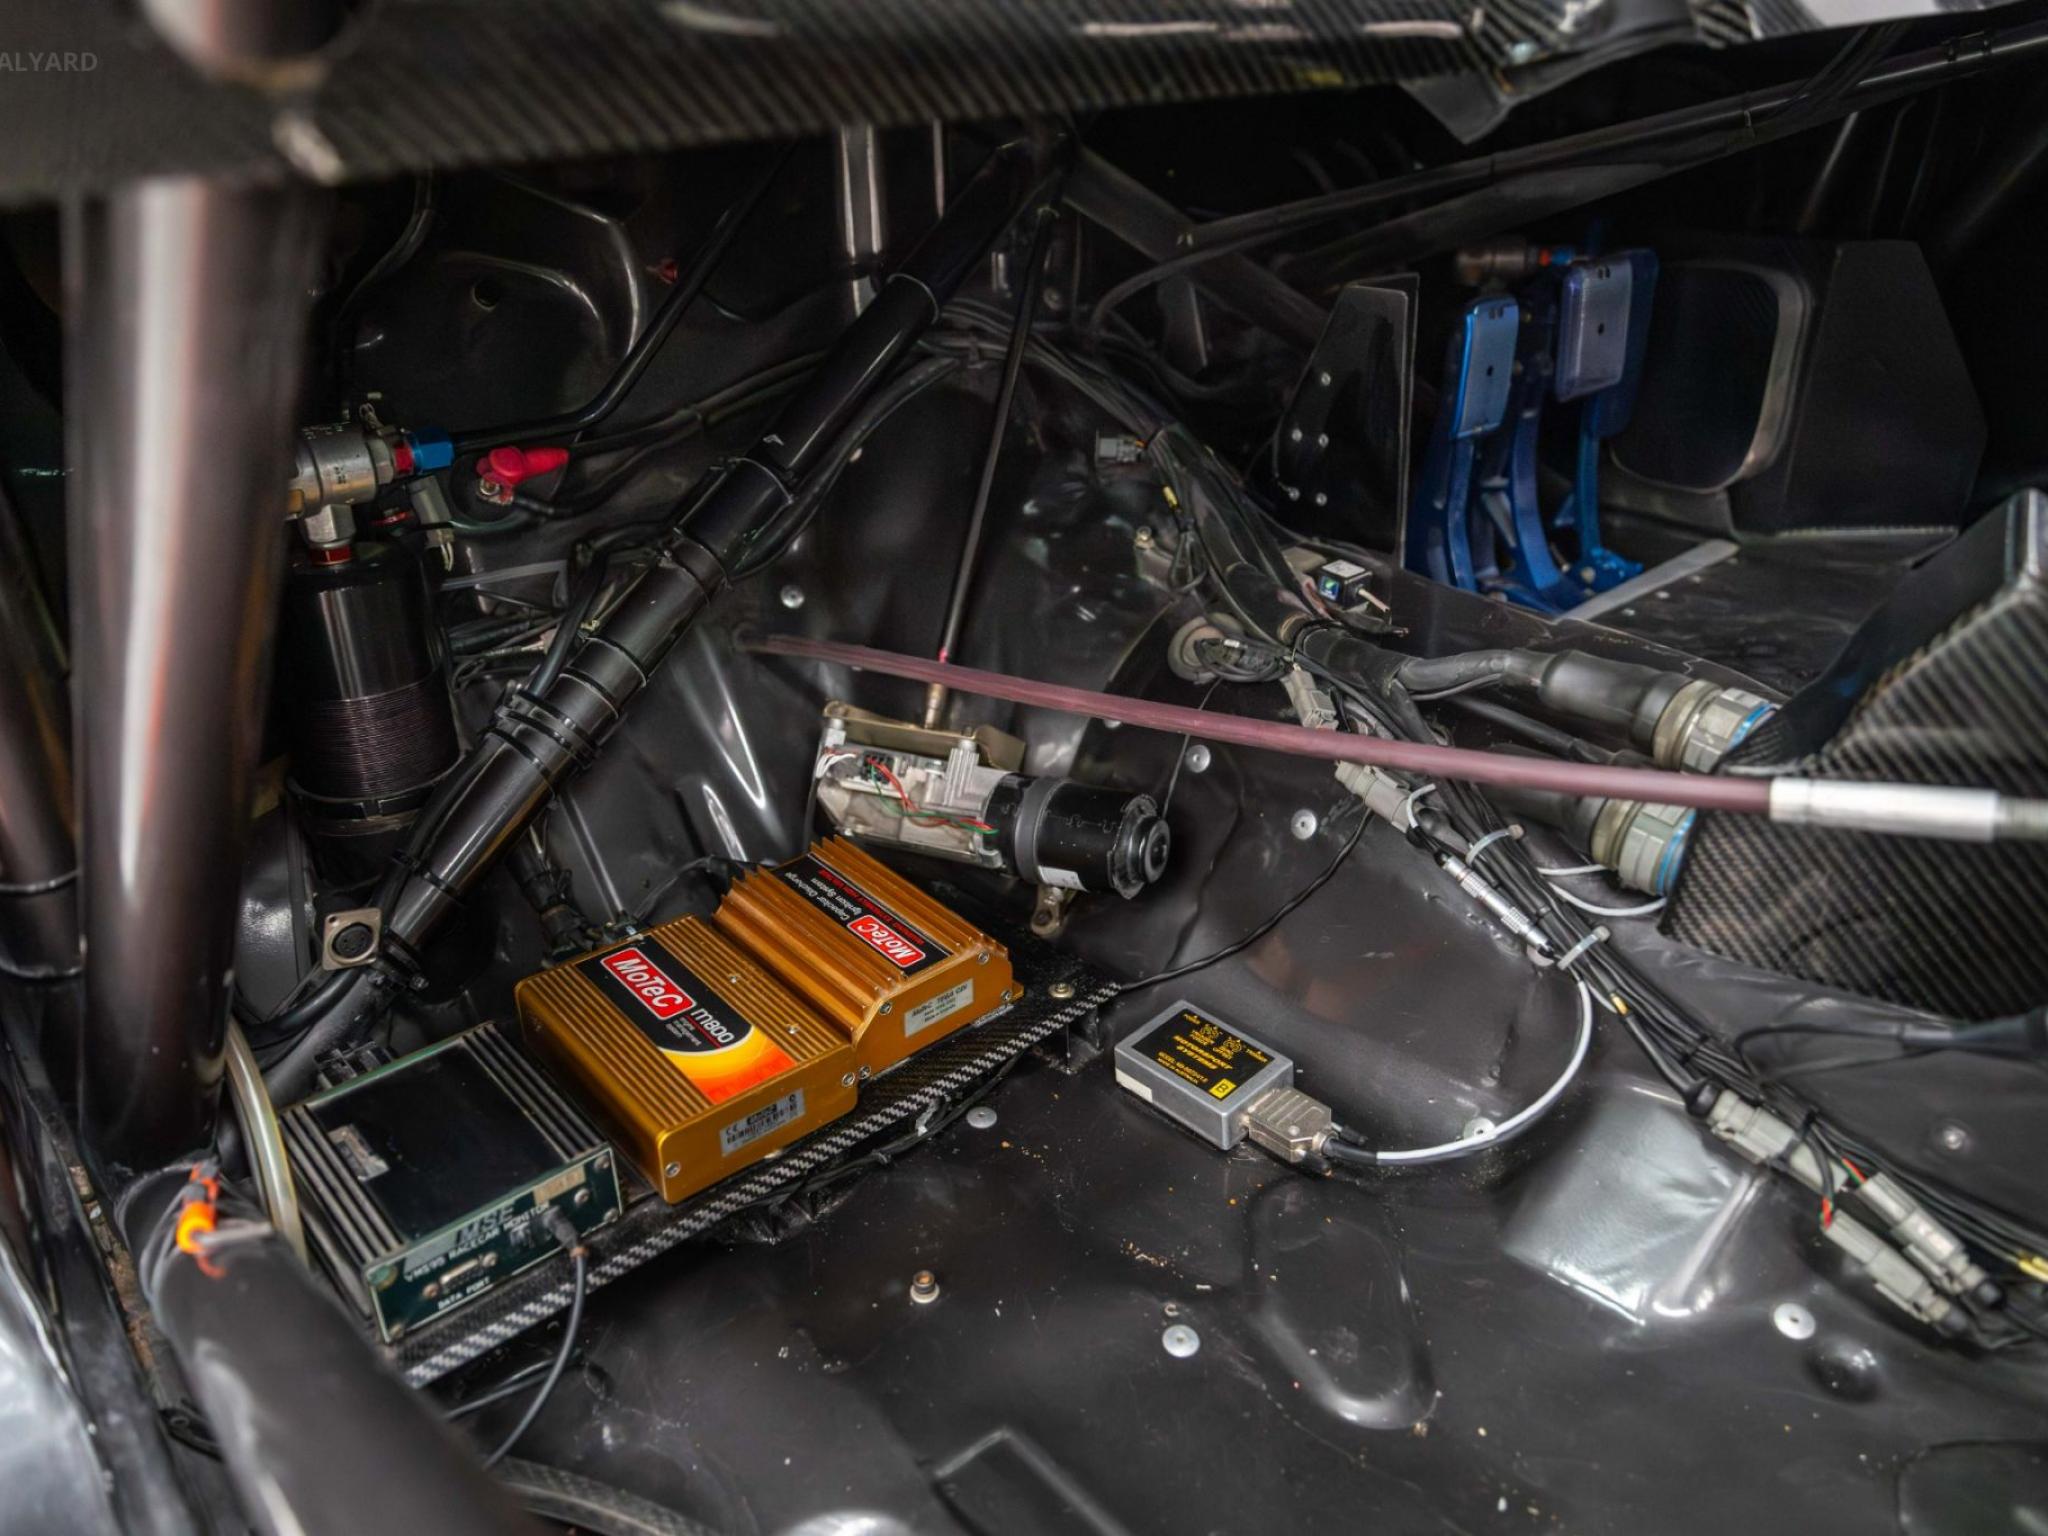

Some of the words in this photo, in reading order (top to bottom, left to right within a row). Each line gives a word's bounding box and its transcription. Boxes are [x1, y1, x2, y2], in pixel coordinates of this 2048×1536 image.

[810, 878, 837, 897] System
[817, 896, 850, 920] Capacitor
[835, 896, 862, 915] Ignition
[857, 923, 916, 959] MoTeC
[613, 958, 683, 1007] MoTeC
[449, 1228, 500, 1260] RACECAR
[503, 1203, 550, 1231] MONITOR
[458, 1206, 514, 1243] MSE
[438, 1292, 463, 1310] DATA
[466, 1276, 490, 1294] PORT
